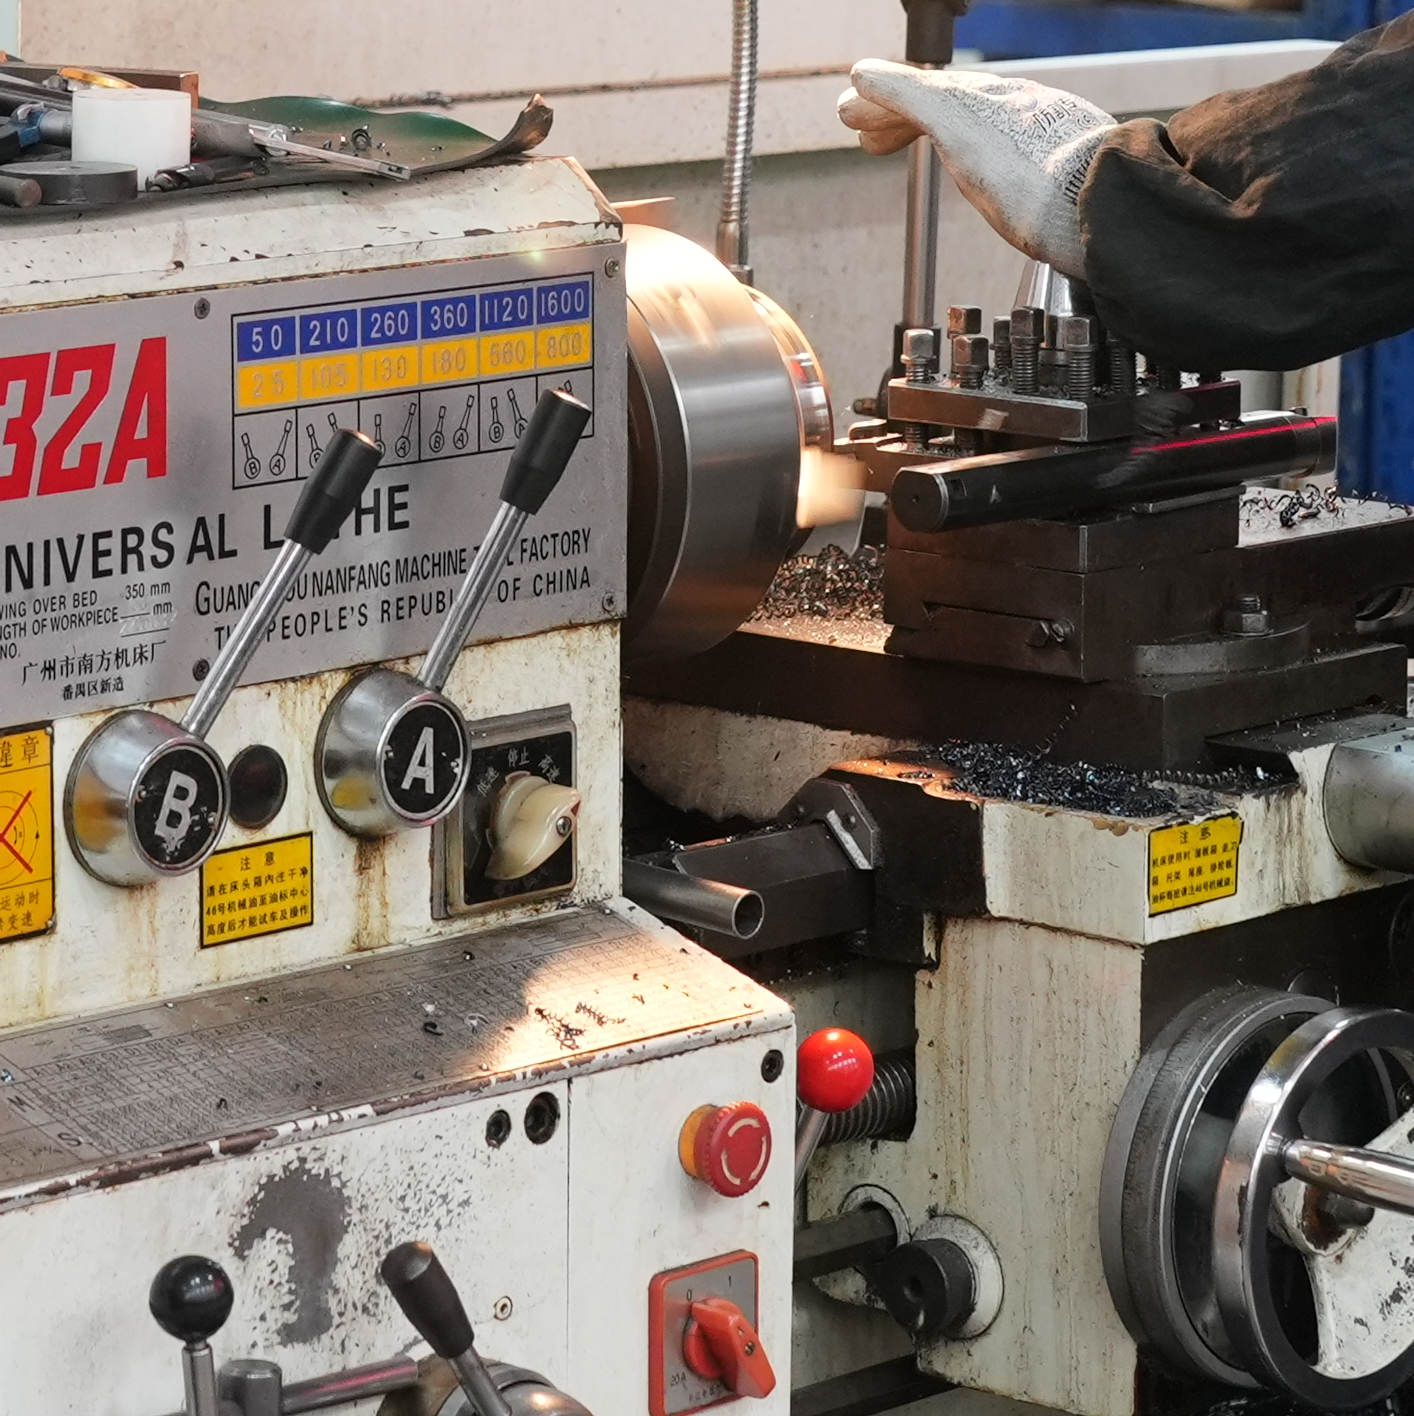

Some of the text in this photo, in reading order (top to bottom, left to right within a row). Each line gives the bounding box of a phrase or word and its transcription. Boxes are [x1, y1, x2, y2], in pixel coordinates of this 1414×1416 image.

[251, 287, 585, 353] 50 210 260 360 1120 1600
[252, 371, 285, 399] 25
[310, 361, 349, 391] 105
[371, 354, 408, 383] 130
[432, 347, 469, 377] 180
[264, 484, 410, 550] LHE
[312, 559, 391, 598] NANFANG
[395, 548, 467, 585] MACHINE
[520, 527, 591, 564] FACTORY
[497, 577, 521, 603] OF
[533, 565, 591, 596] CHINA
[31, 618, 49, 636] OF
[50, 606, 119, 632] WORKPIECE
[153, 600, 172, 615] mm
[33, 593, 66, 615] OVER
[72, 590, 98, 609] BED
[125, 581, 145, 601] 350
[150, 581, 170, 596] mm
[0, 640, 21, 659] NO.
[22, 640, 167, 686] 广州市南方机床厂
[401, 726, 435, 795] A
[507, 746, 530, 768] 停止
